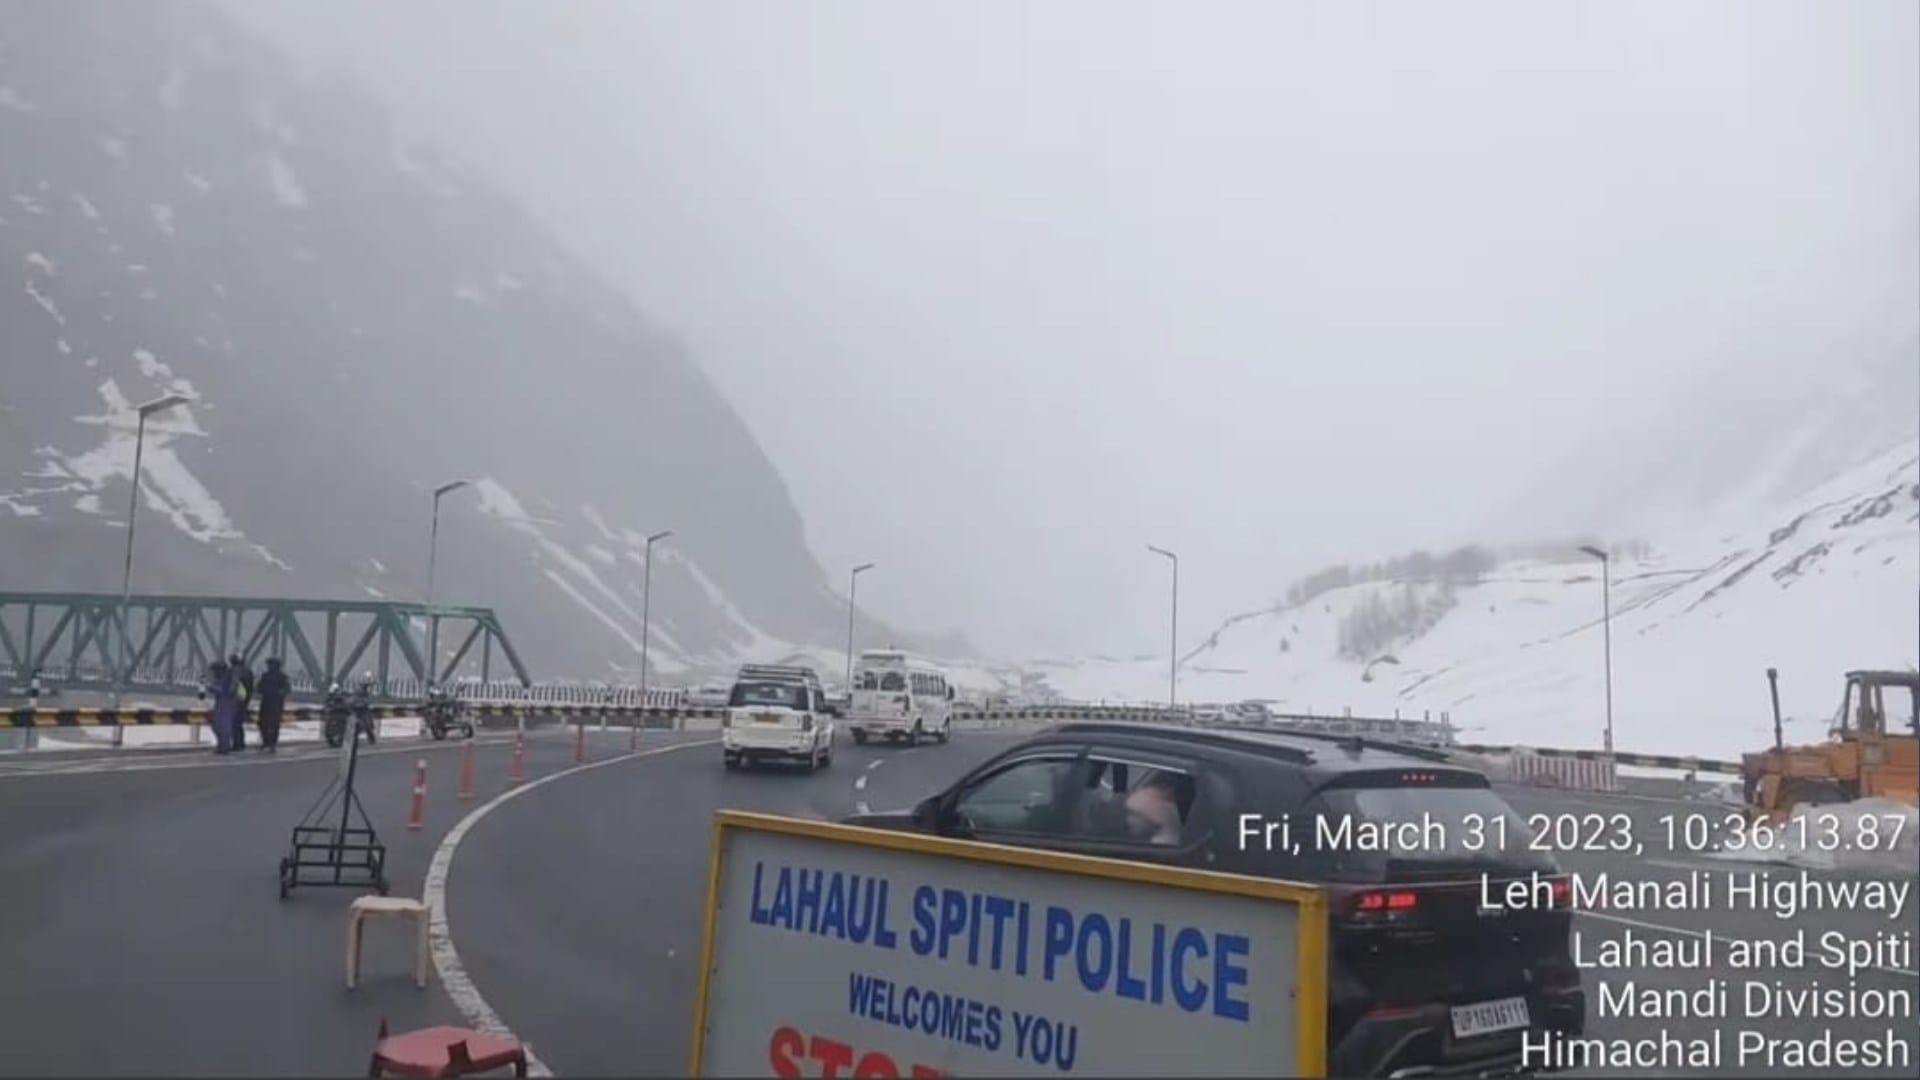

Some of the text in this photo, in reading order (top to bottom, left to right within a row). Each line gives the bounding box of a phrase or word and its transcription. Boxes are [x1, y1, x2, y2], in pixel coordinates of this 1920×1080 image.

[749, 861, 1251, 1022] LAHAUL SPITI POLICE
[768, 1026, 953, 1078] ST
[848, 972, 1078, 1071] WELCOMES YOU
